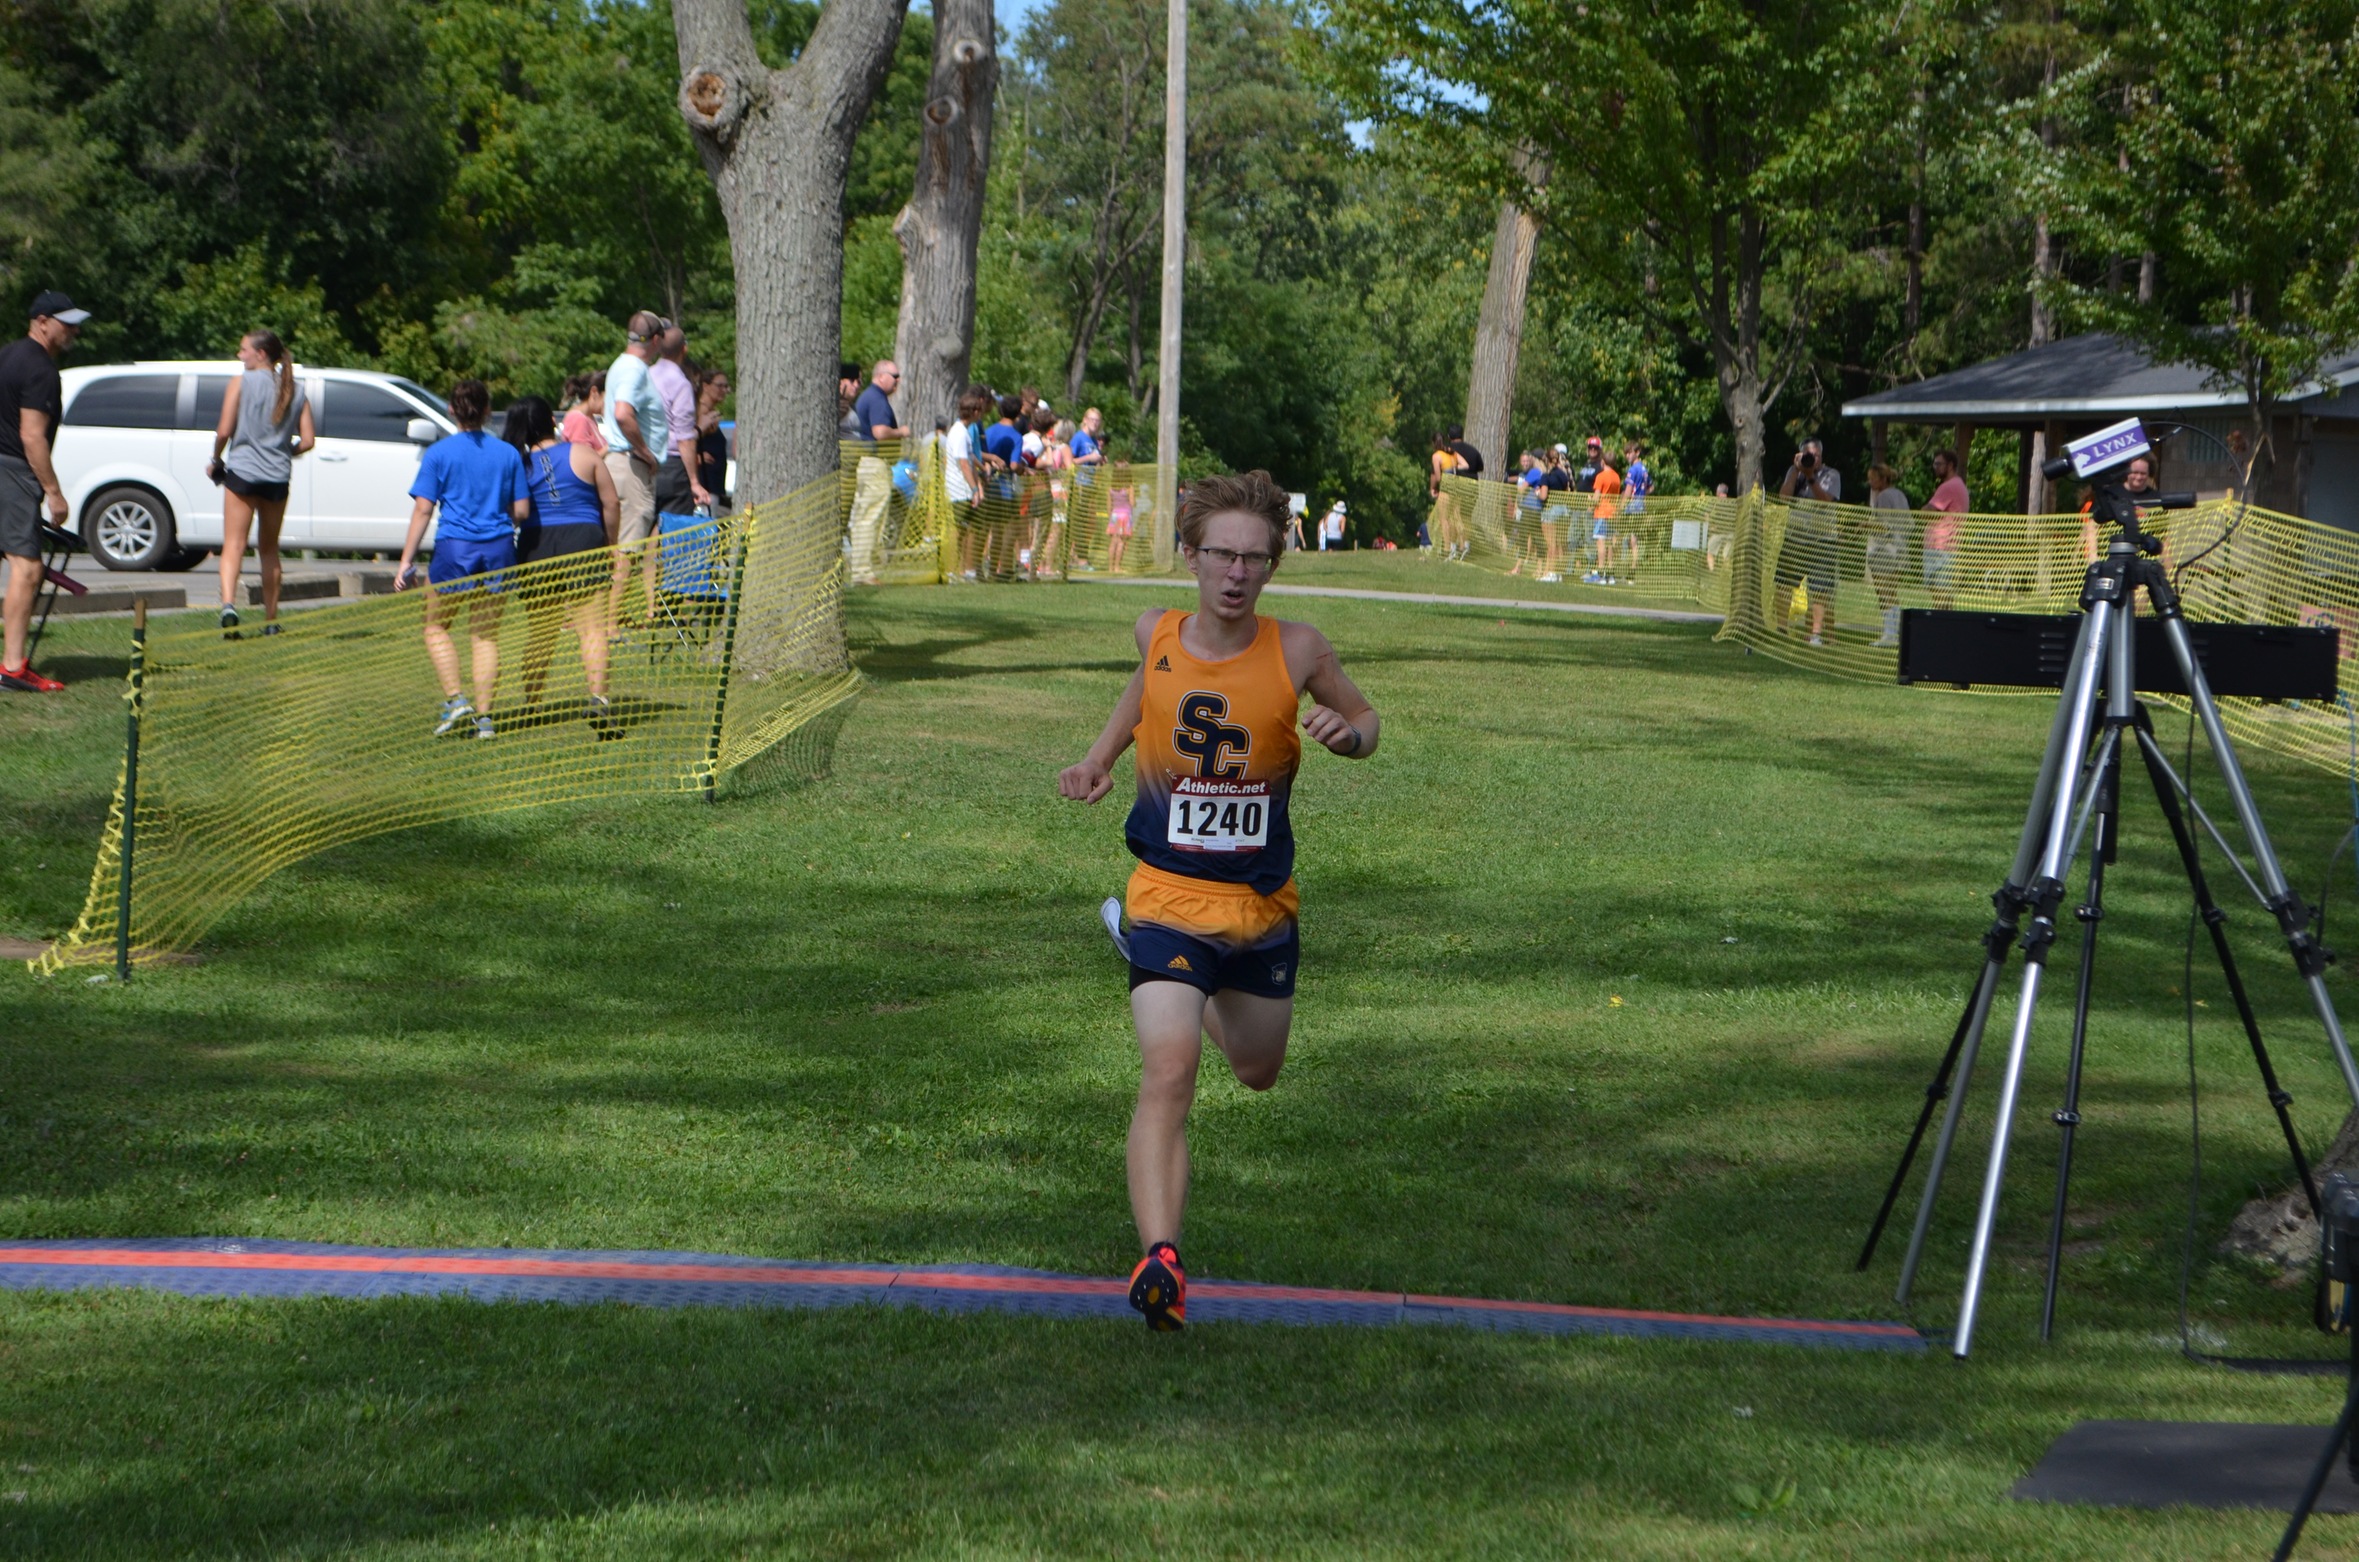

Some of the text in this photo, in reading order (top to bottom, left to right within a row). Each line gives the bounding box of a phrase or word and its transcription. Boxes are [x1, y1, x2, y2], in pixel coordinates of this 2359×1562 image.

[2093, 433, 2137, 458] LYNX
[1154, 665, 1172, 673] adidas
[1175, 777, 1266, 794] Athletic.net
[1177, 800, 1262, 836] 1240
